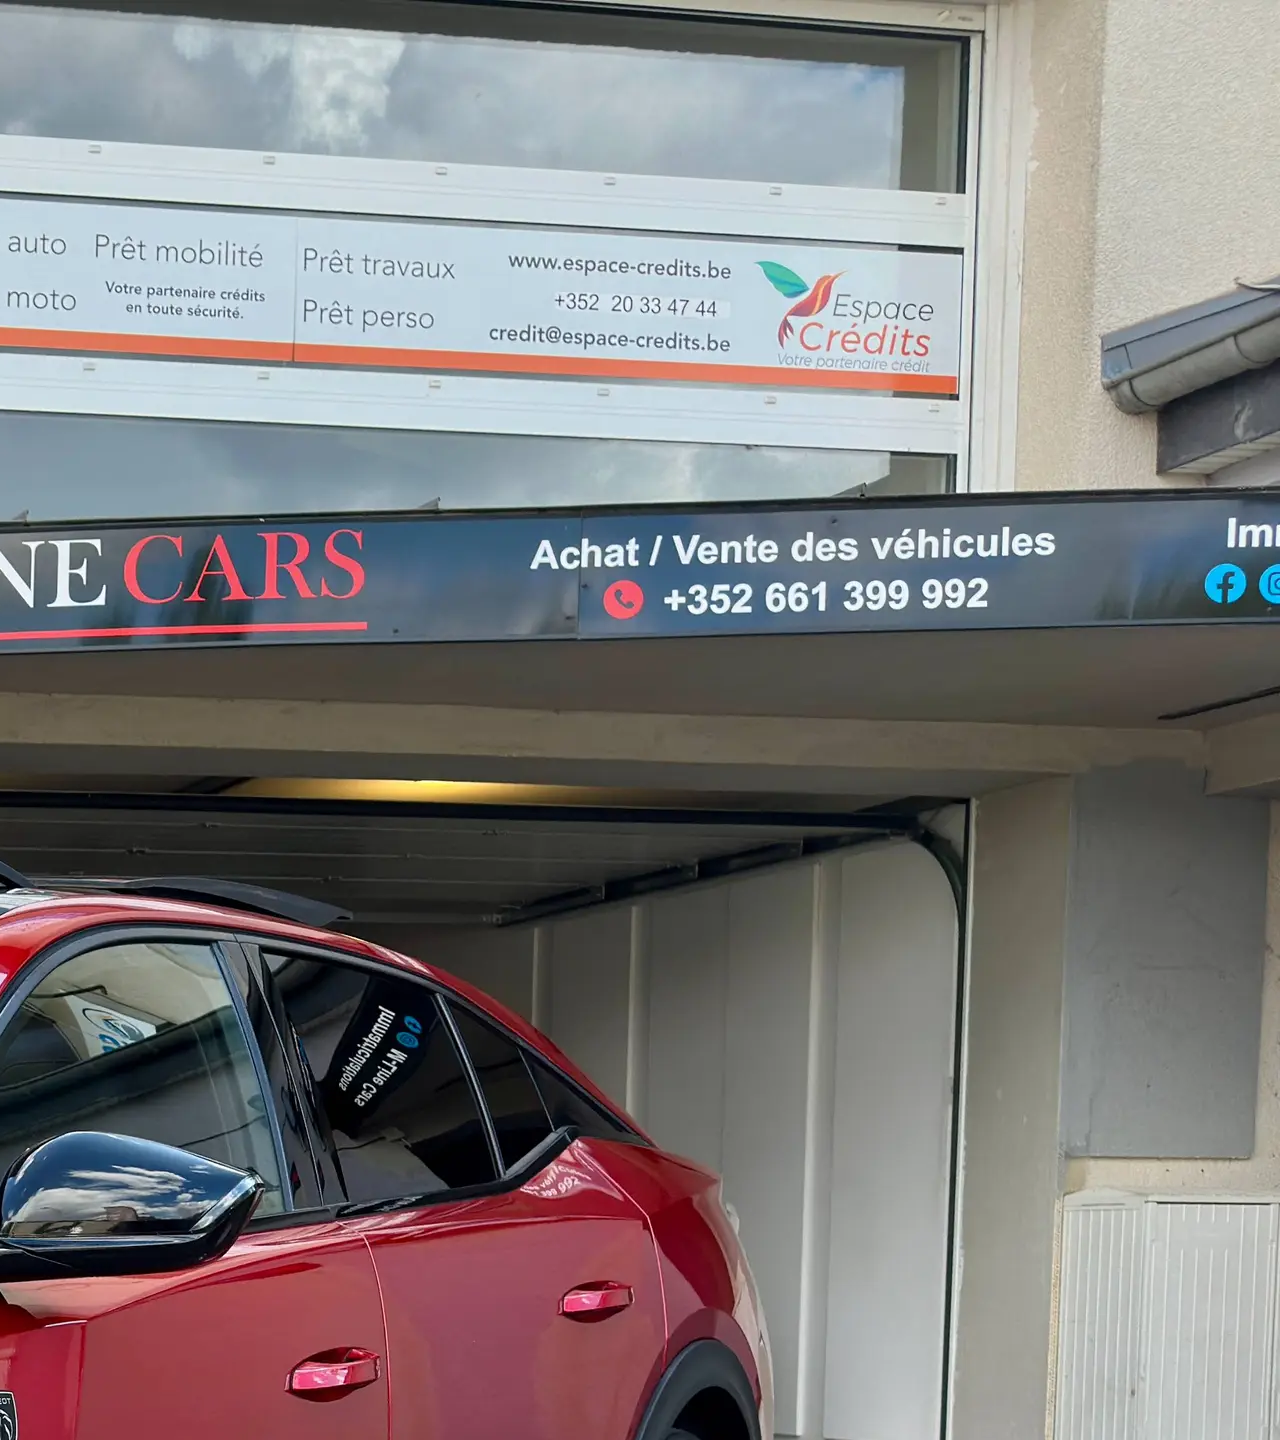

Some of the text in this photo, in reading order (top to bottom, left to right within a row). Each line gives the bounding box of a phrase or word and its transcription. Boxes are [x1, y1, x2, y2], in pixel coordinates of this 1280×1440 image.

[8, 233, 67, 257] auto
[95, 234, 264, 268] Prêt mobilité
[303, 248, 456, 280] Prêt travaux
[509, 252, 732, 280] www.espace-credits.be
[7, 288, 77, 311] moto
[105, 281, 266, 302] Votre partenaire crédits
[554, 293, 717, 318] +352 20 33 47 44
[126, 303, 244, 320] en toute sécurité.
[302, 298, 434, 334] Prêt perso
[832, 294, 934, 324] Espace
[489, 325, 731, 353] credit@espace-credits.be
[798, 321, 930, 358] Crédits
[777, 353, 930, 373] Votre partenaire crédit
[1226, 516, 1280, 548] Im
[530, 525, 1056, 571] Achat / Vente des véhicules
[123, 528, 366, 605] CARS
[664, 578, 988, 615] +352 661 399 992
